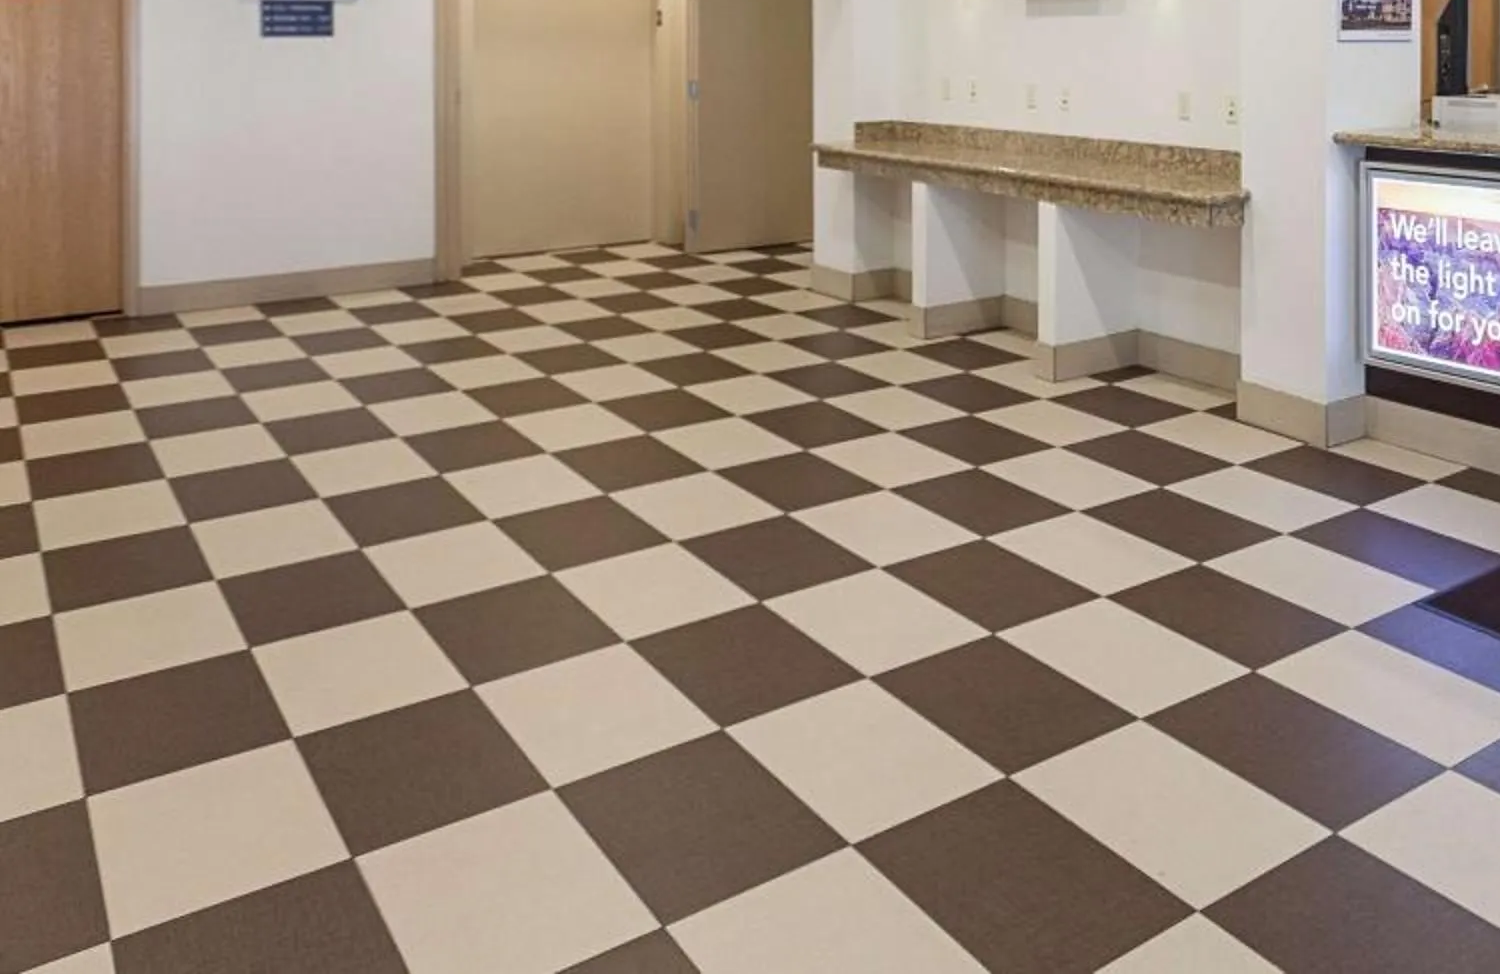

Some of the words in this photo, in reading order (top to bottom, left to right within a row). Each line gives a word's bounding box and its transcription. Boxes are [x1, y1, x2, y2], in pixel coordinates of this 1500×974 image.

[1388, 212, 1448, 247] We'll
[1390, 252, 1429, 285] the
[1438, 258, 1498, 300] light
[1391, 301, 1421, 326] on
[1429, 298, 1466, 334] for
